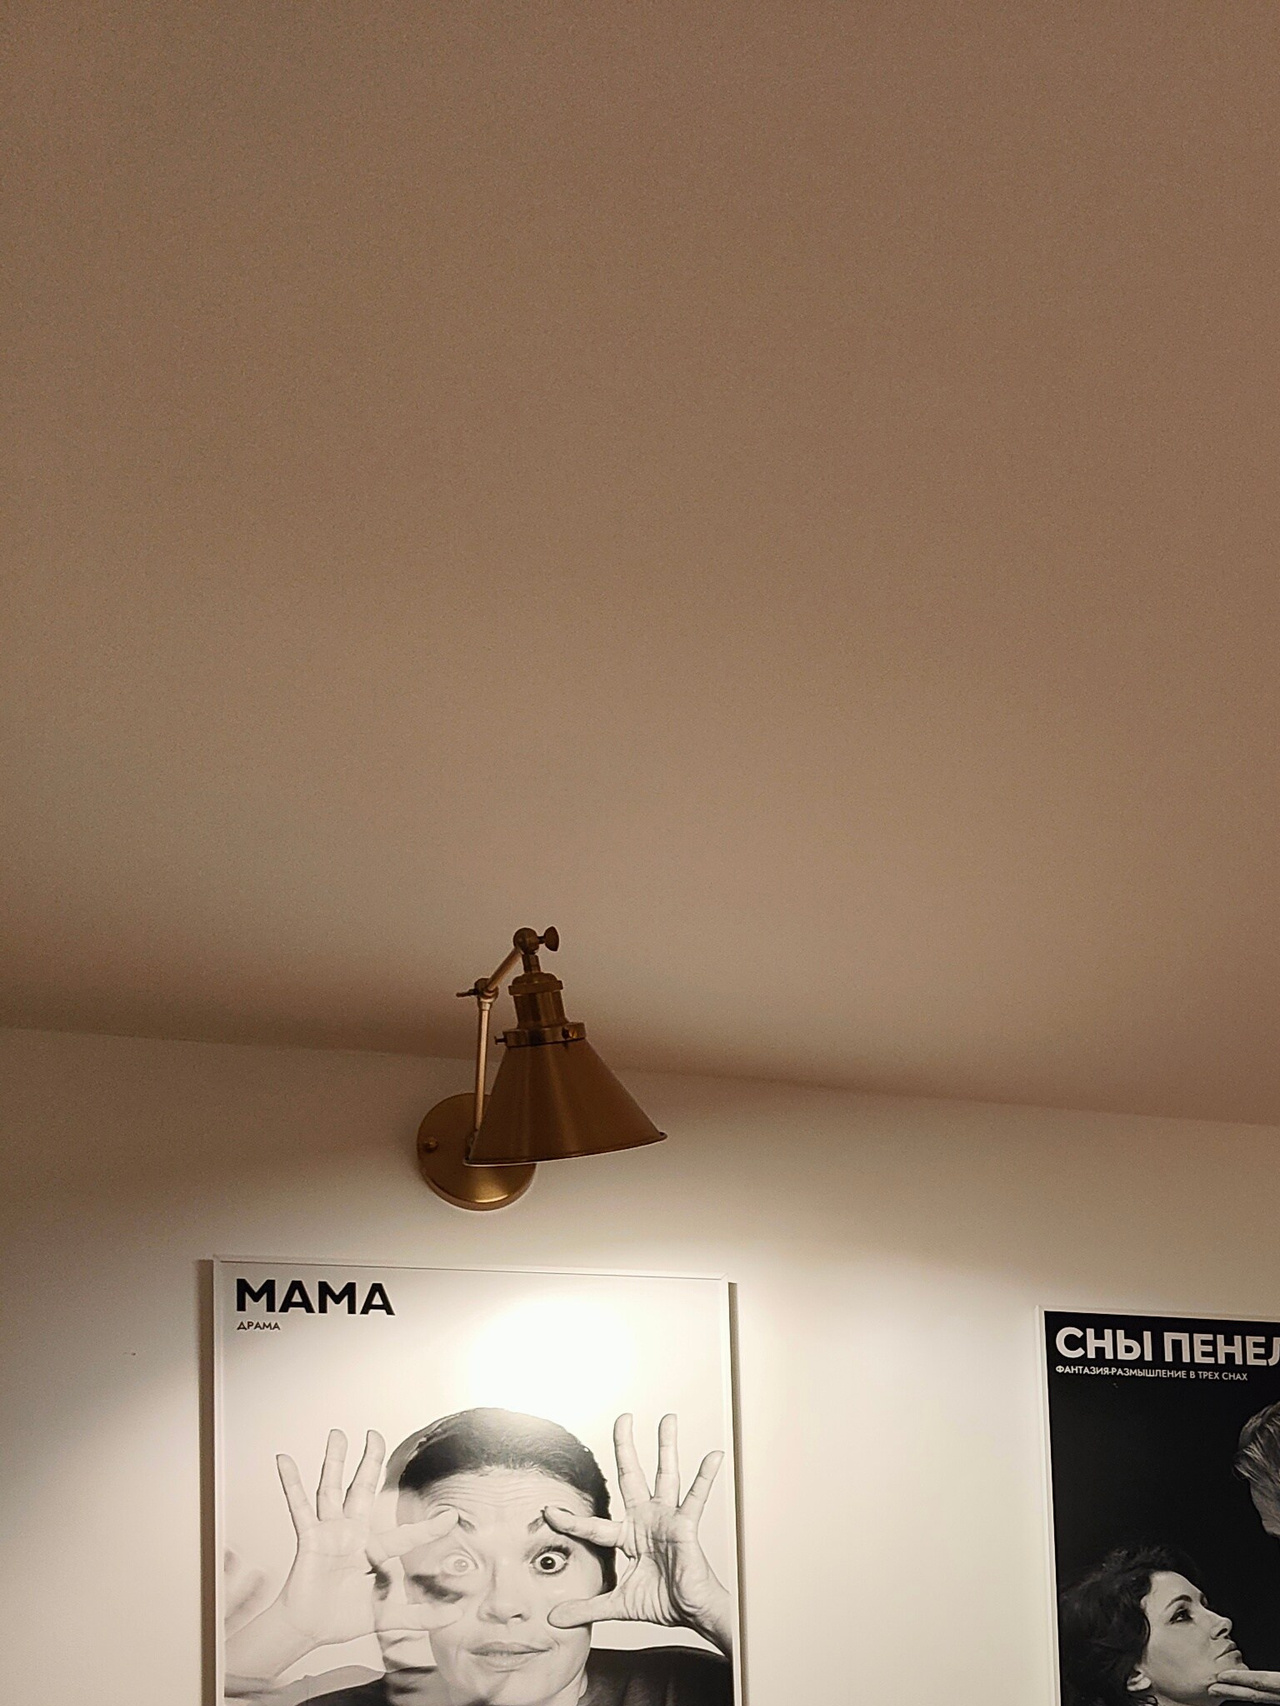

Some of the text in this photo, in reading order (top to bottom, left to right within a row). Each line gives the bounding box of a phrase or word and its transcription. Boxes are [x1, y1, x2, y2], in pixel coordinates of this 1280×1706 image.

[236, 1278, 395, 1316] МАМА
[237, 1321, 280, 1331] ДРАМА
[1055, 1327, 1153, 1361] СНЫ
[1055, 1365, 1248, 1382] ФАНТАЗИЯ-РАЗМЫШЛЕНИЕ В ТРЕХ СНАХ
